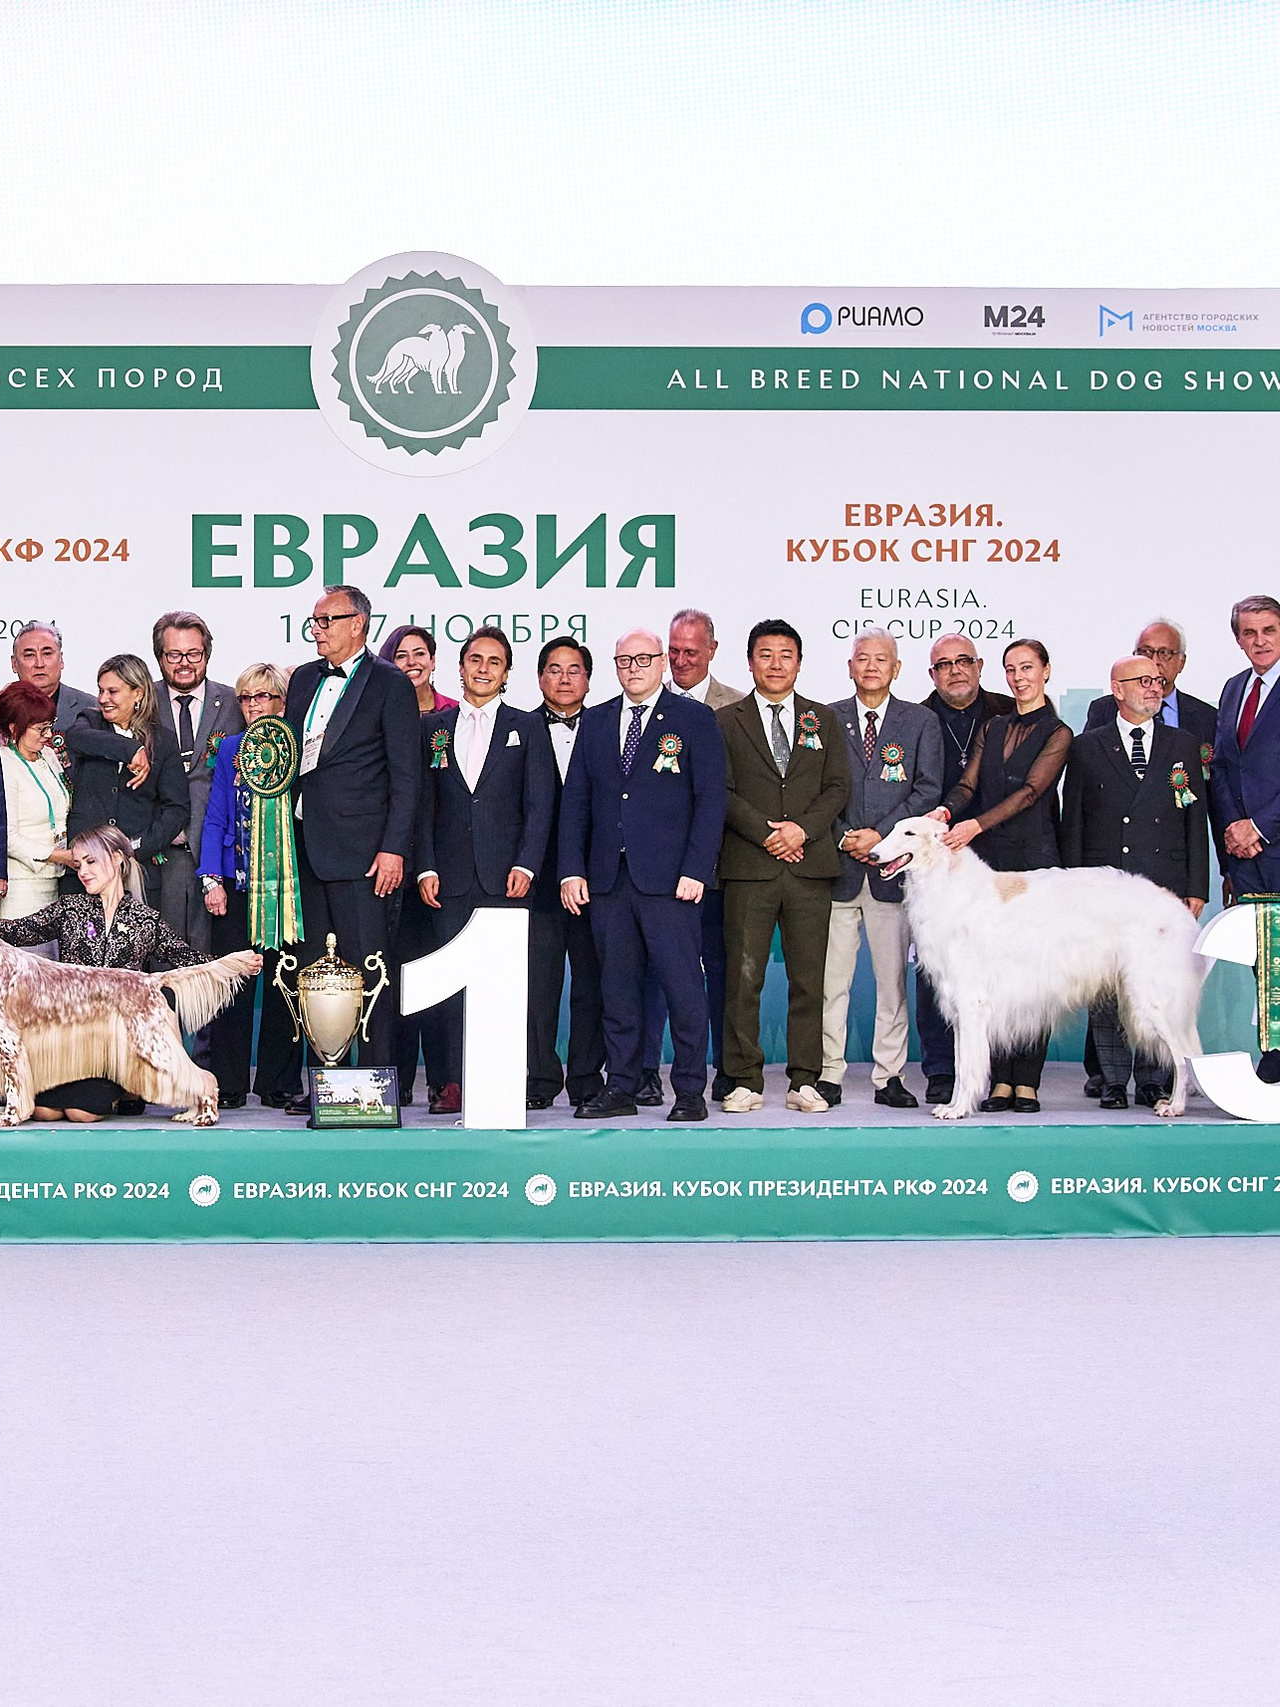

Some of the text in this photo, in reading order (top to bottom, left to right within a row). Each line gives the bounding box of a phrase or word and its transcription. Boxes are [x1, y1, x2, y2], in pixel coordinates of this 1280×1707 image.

[1142, 313, 1259, 322] АГЕНТСТВО ГОРОДСКИХ
[1143, 323, 1238, 332] НОВОСТЕЙ МОСКВА
[99, 368, 222, 392] ПОРОД
[667, 369, 1280, 390] ALL BREED NATIONAL DOG SHOW
[846, 504, 1002, 527] ЕВРАЗИЯ.
[55, 539, 129, 562] 2024
[192, 513, 675, 589] ЕВРАЗИЯ
[787, 539, 1060, 562] КУБОК СНГ 2024
[862, 589, 986, 608] EURASIA.
[888, 619, 942, 639] CUP
[954, 619, 1016, 639] 2024
[401, 908, 530, 1130] 1
[75, 1182, 118, 1198] РКФ
[123, 1182, 169, 1198] 2024
[233, 1181, 510, 1199] ЕВРАЗИЯ. КУБОК СНГ 2024
[570, 1178, 988, 1199] ЕВРАЗИЯ. КУБОК ПРЕЗИДЕНТА РКФ 2024
[1052, 1178, 1147, 1193] ЕВРАЗИЯ.
[1154, 1176, 1221, 1193] КУБОК
[1228, 1176, 1268, 1192] СНГ
